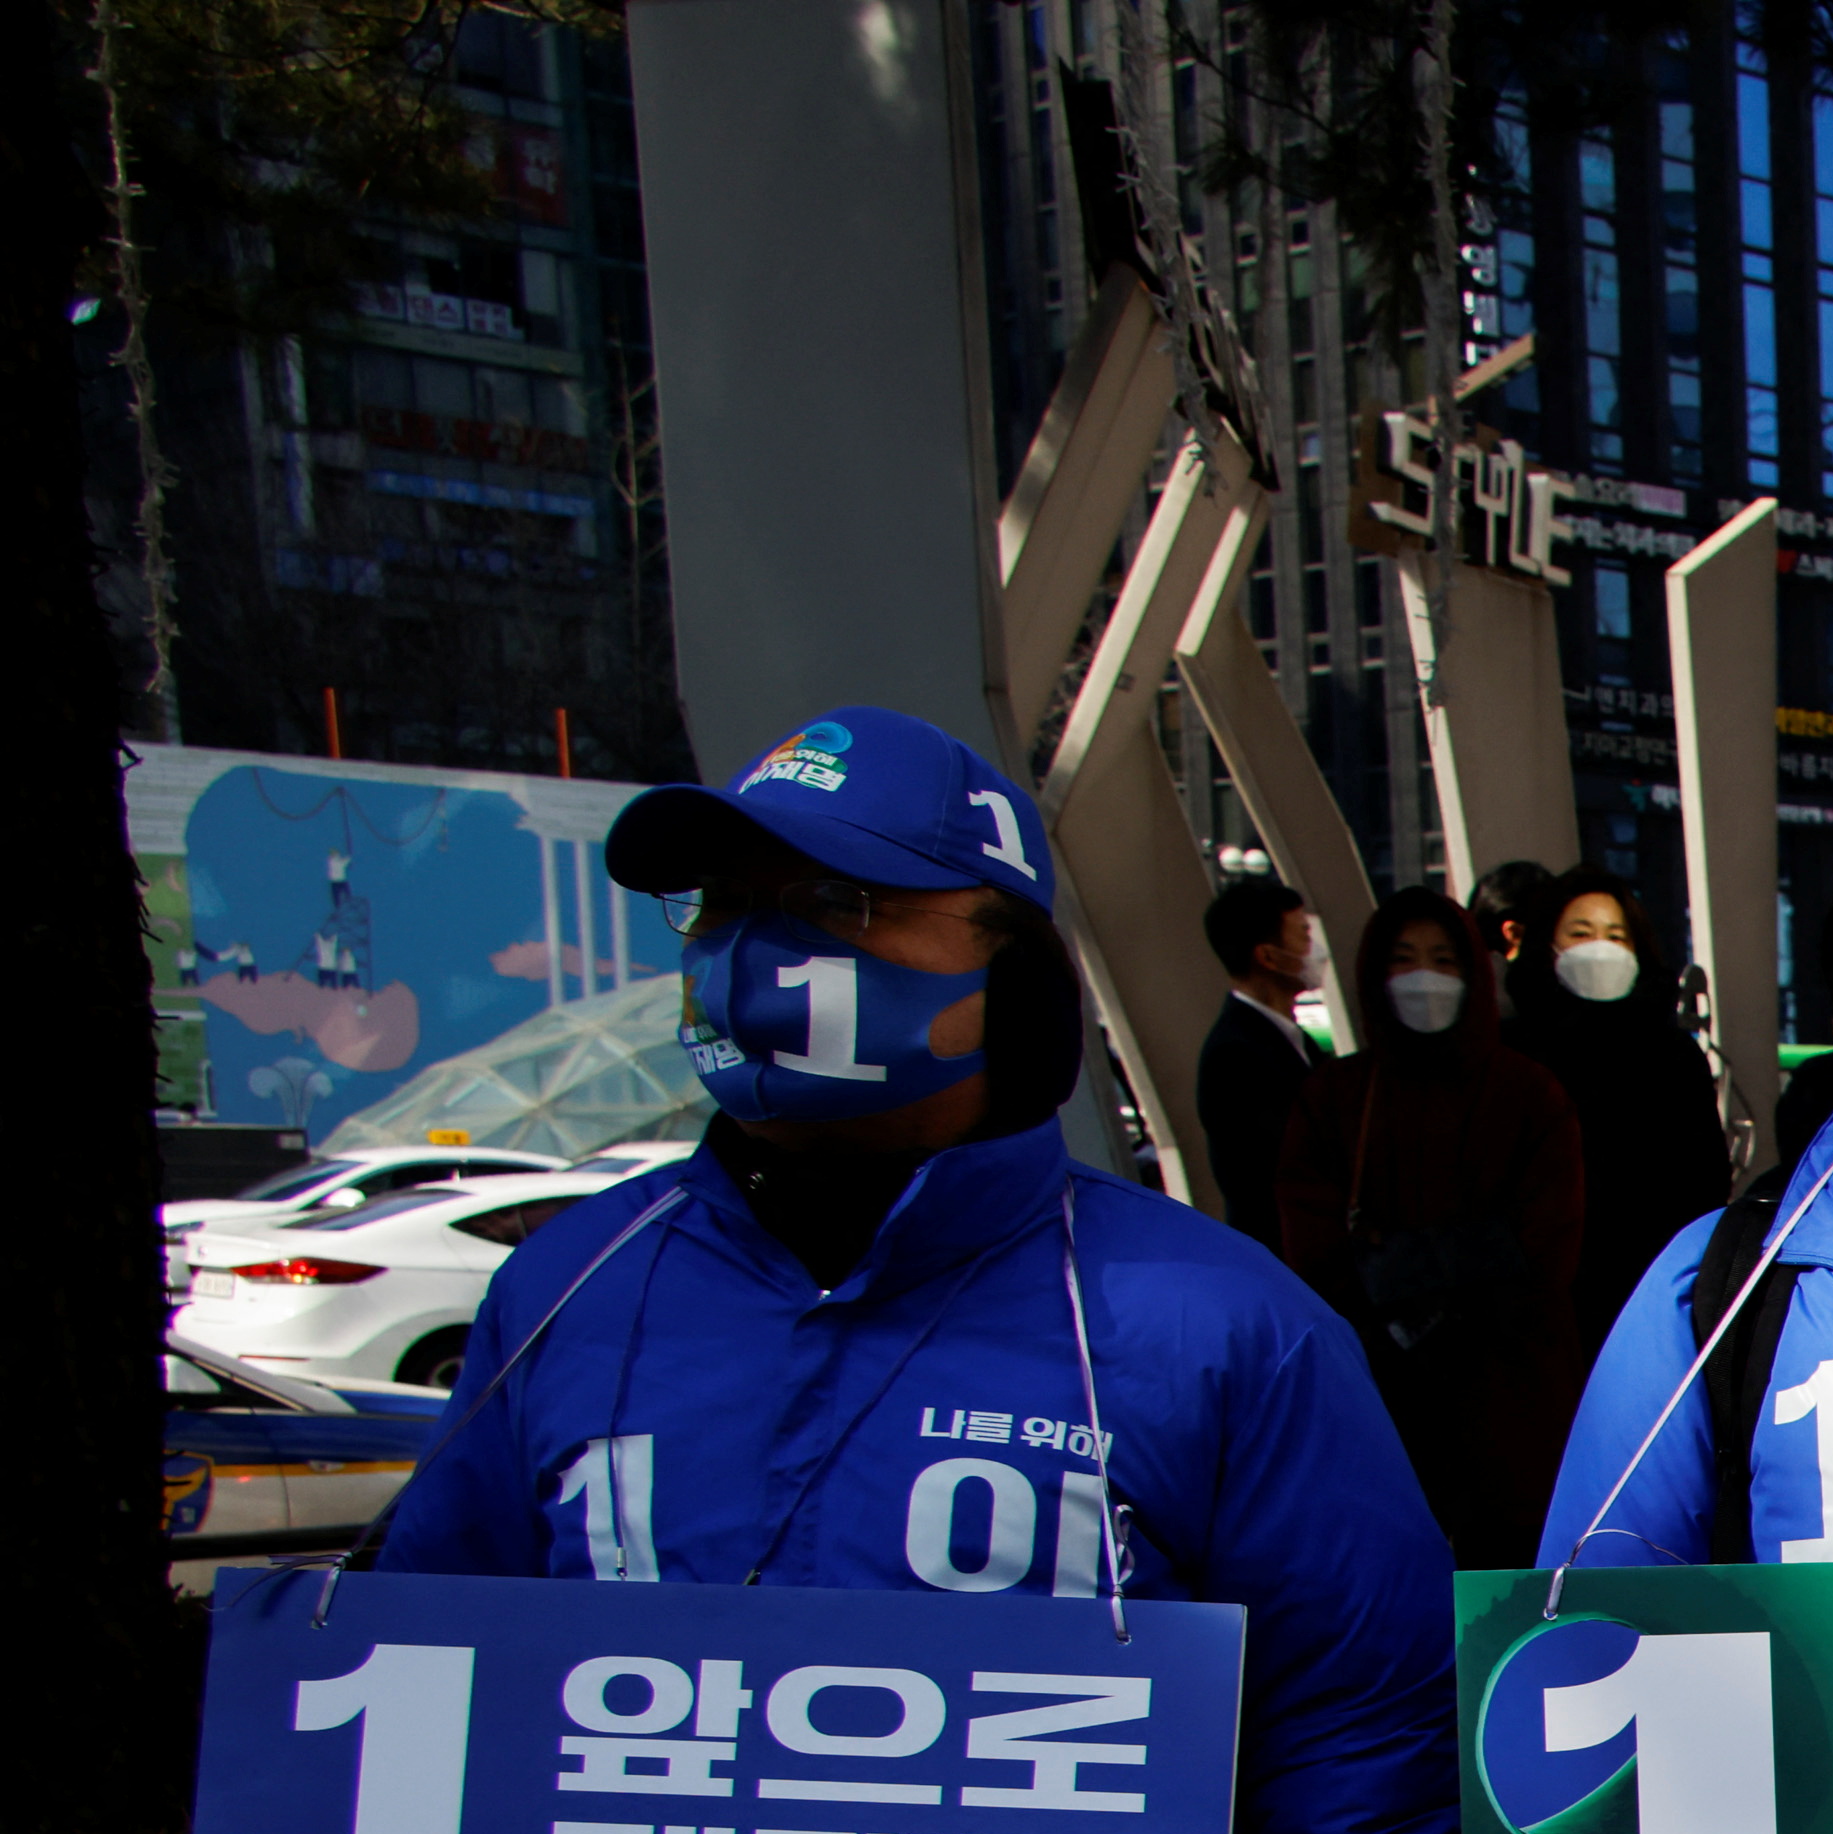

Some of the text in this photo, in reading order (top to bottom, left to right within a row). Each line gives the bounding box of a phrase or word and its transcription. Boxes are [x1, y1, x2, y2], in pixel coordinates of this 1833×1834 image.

[968, 790, 1037, 882] 1
[773, 956, 887, 1082] 1
[919, 1406, 1113, 1464] 나를 위해
[558, 1433, 661, 1582] 1
[558, 1655, 1152, 1813] 앞으로
